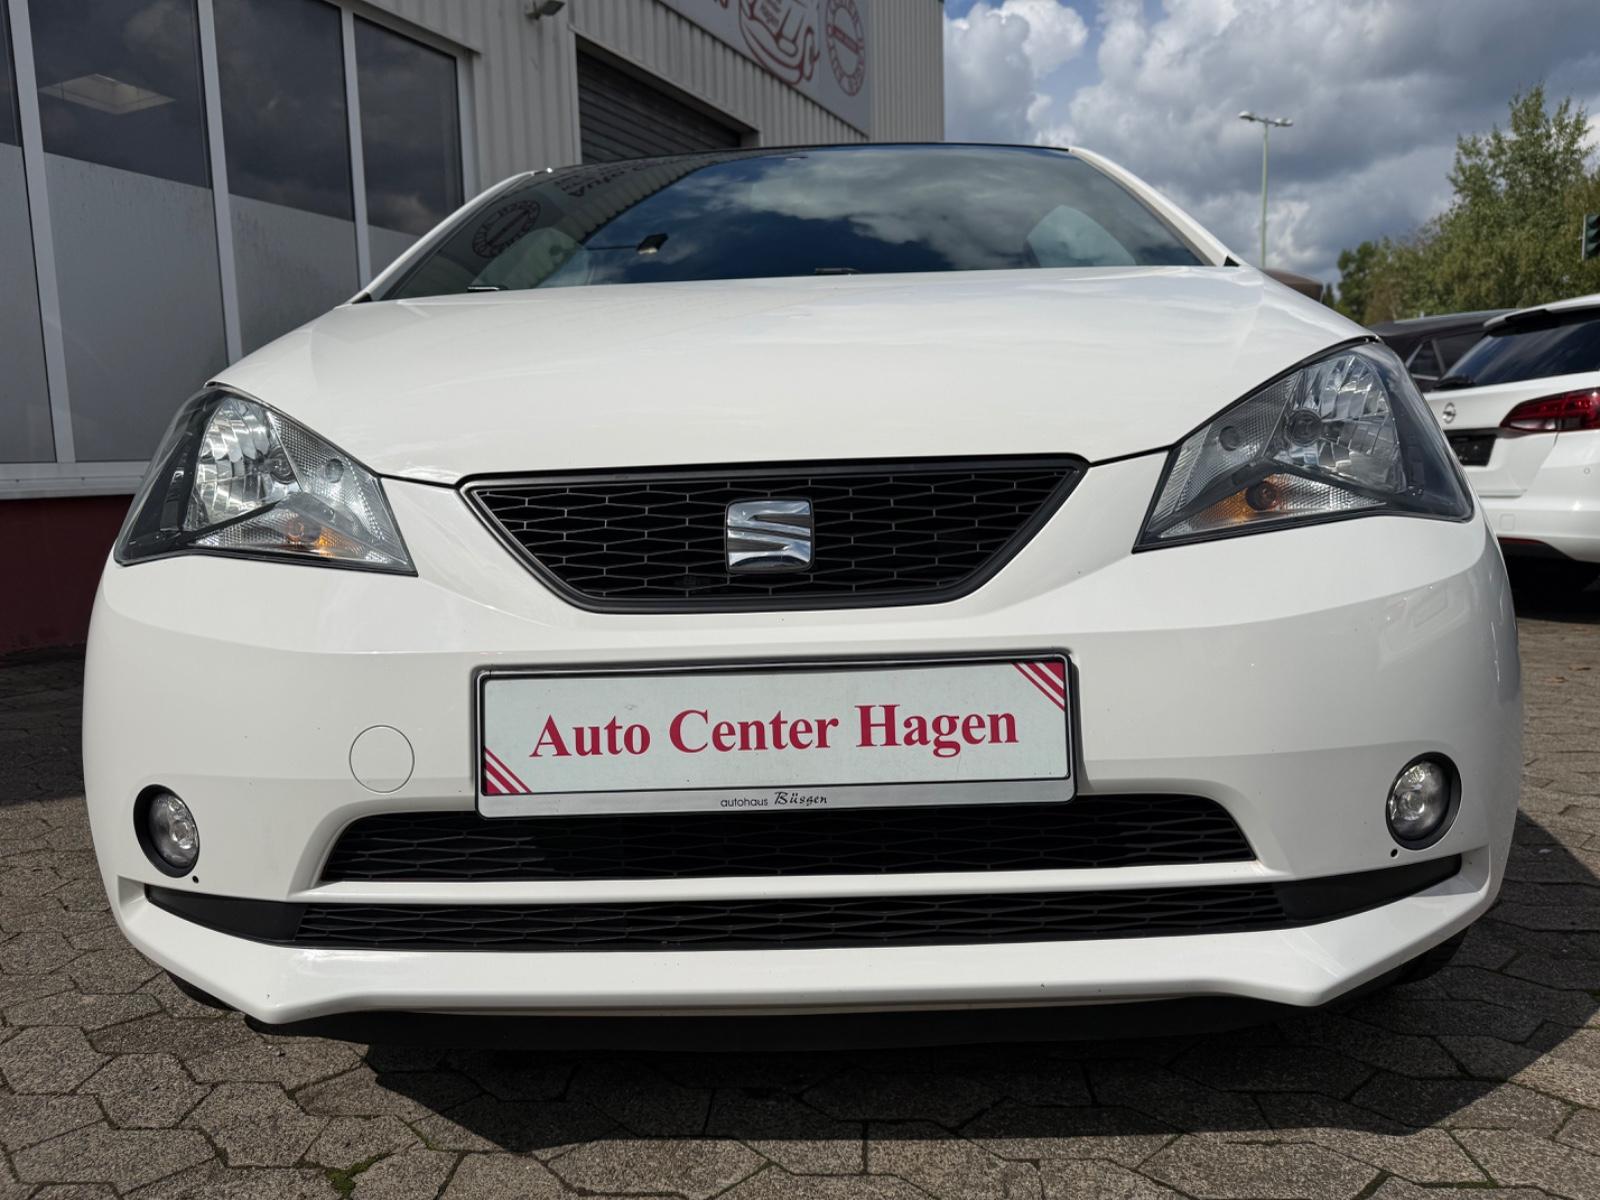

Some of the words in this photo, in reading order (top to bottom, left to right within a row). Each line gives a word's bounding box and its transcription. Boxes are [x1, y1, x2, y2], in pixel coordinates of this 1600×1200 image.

[529, 715, 651, 758] Auto
[668, 709, 839, 752] Center
[855, 704, 1019, 758] Hagen
[720, 797, 768, 808] autohaus
[774, 791, 828, 807] Büsgen
